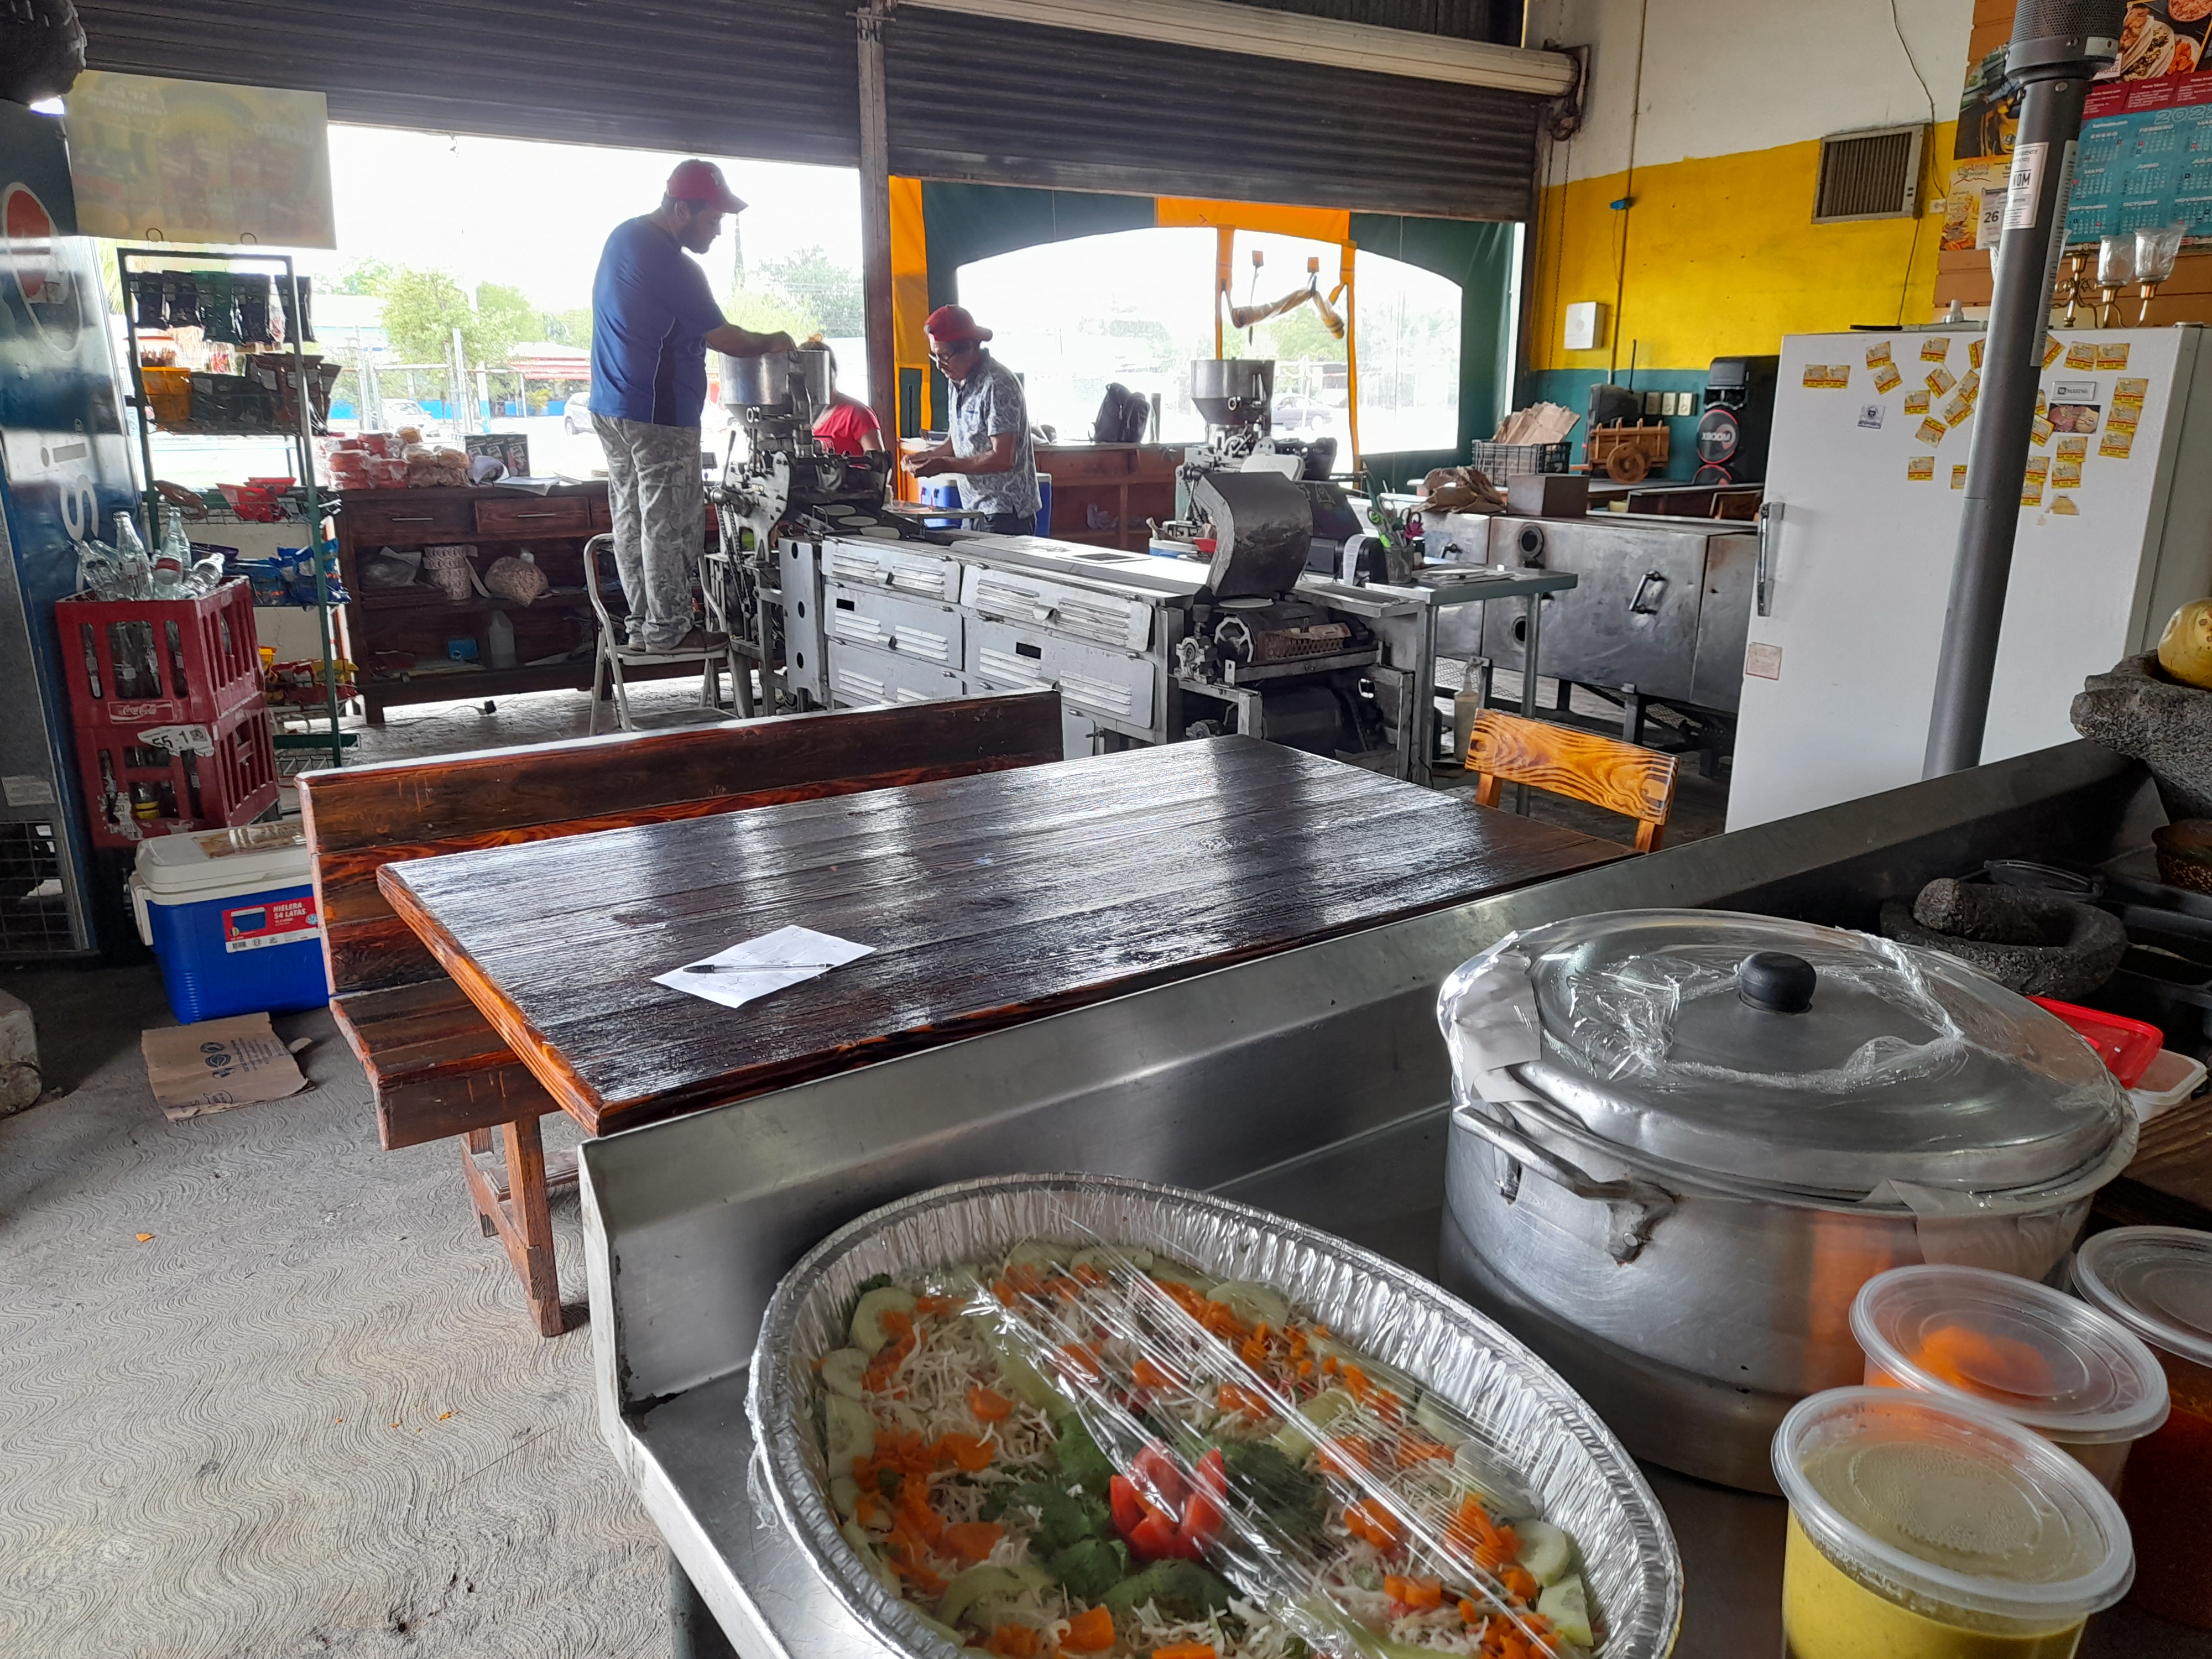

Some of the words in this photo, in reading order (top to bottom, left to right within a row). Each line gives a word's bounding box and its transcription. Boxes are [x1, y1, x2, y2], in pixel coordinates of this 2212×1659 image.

[2138, 123, 2174, 133] FEBRERO
[1983, 211, 2000, 223] 26
[122, 703, 157, 716] Coca-Cola
[272, 901, 302, 912] HIELERA
[285, 908, 306, 918] LATAS
